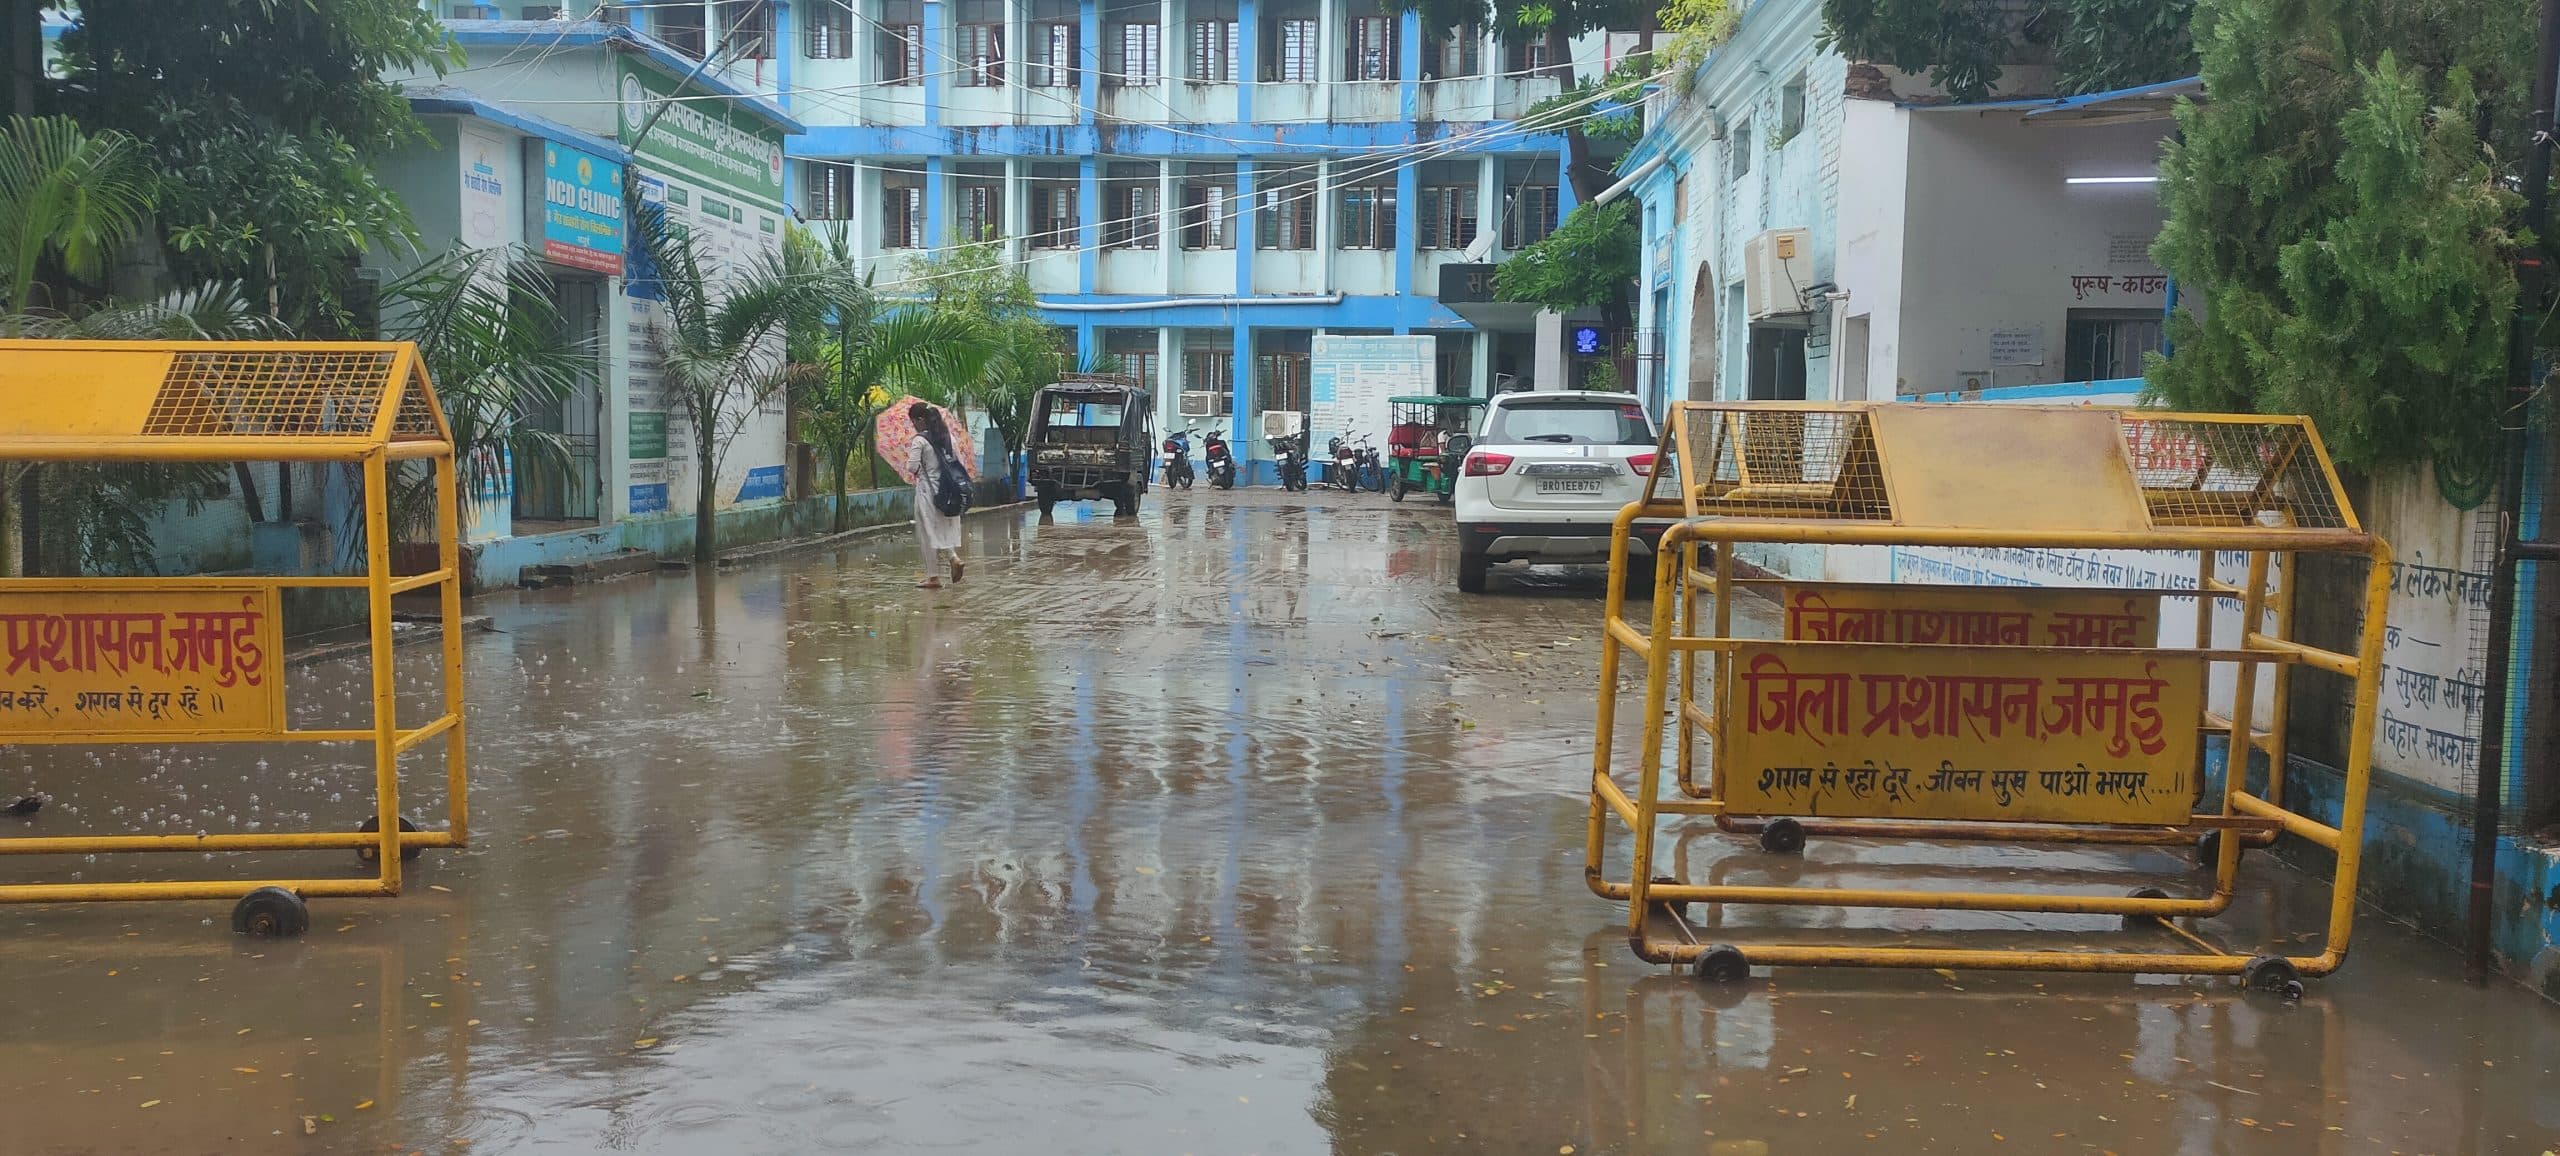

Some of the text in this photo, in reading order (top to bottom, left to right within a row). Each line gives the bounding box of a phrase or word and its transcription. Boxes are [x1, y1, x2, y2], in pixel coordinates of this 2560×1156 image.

[546, 177, 576, 208] NCD
[578, 186, 620, 220] CLINIC
[1542, 480, 1601, 491] BR01EE8767
[2407, 550, 2457, 606] लेकर
[75, 692, 123, 719] शराब
[126, 686, 144, 719] से
[148, 692, 175, 720] दूर
[1742, 653, 1853, 748] जिला
[2396, 667, 2440, 710] सुरक्षा
[1758, 767, 1815, 799] शराब
[1819, 761, 1841, 799] से
[1845, 760, 1880, 800] रहो
[1923, 760, 1986, 793] जीवन
[1991, 769, 2029, 807] सुख
[2038, 763, 2091, 797] पाओ
